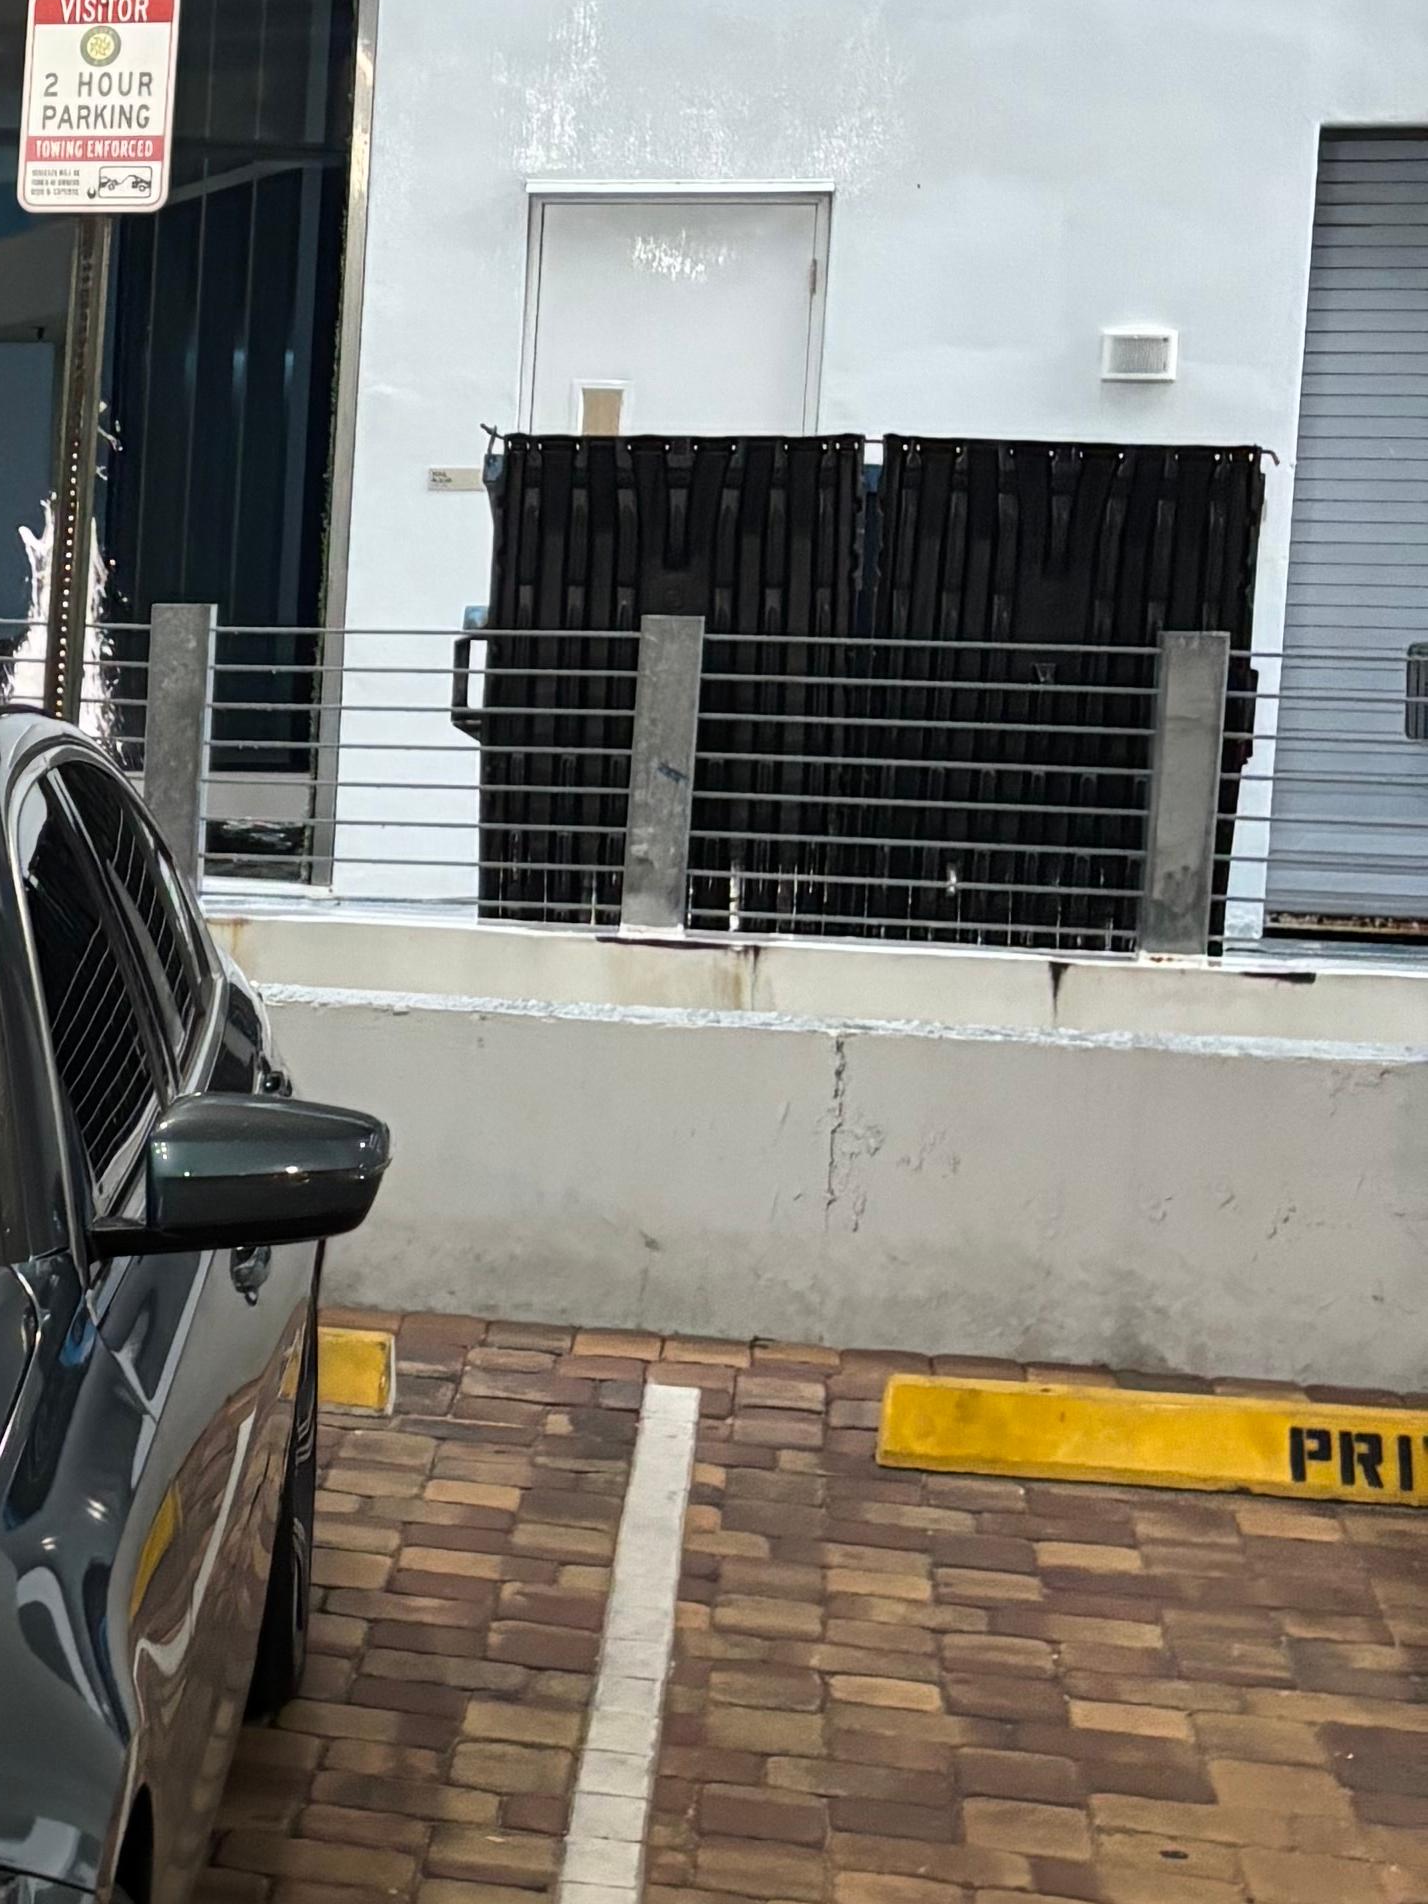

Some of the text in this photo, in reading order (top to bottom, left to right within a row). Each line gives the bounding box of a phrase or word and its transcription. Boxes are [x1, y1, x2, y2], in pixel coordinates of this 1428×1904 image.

[43, 71, 153, 97] 2 HOUR
[42, 104, 151, 130] PARKING
[36, 139, 153, 158] TOWING ENFORCED
[1289, 1426, 1428, 1492] PRI
